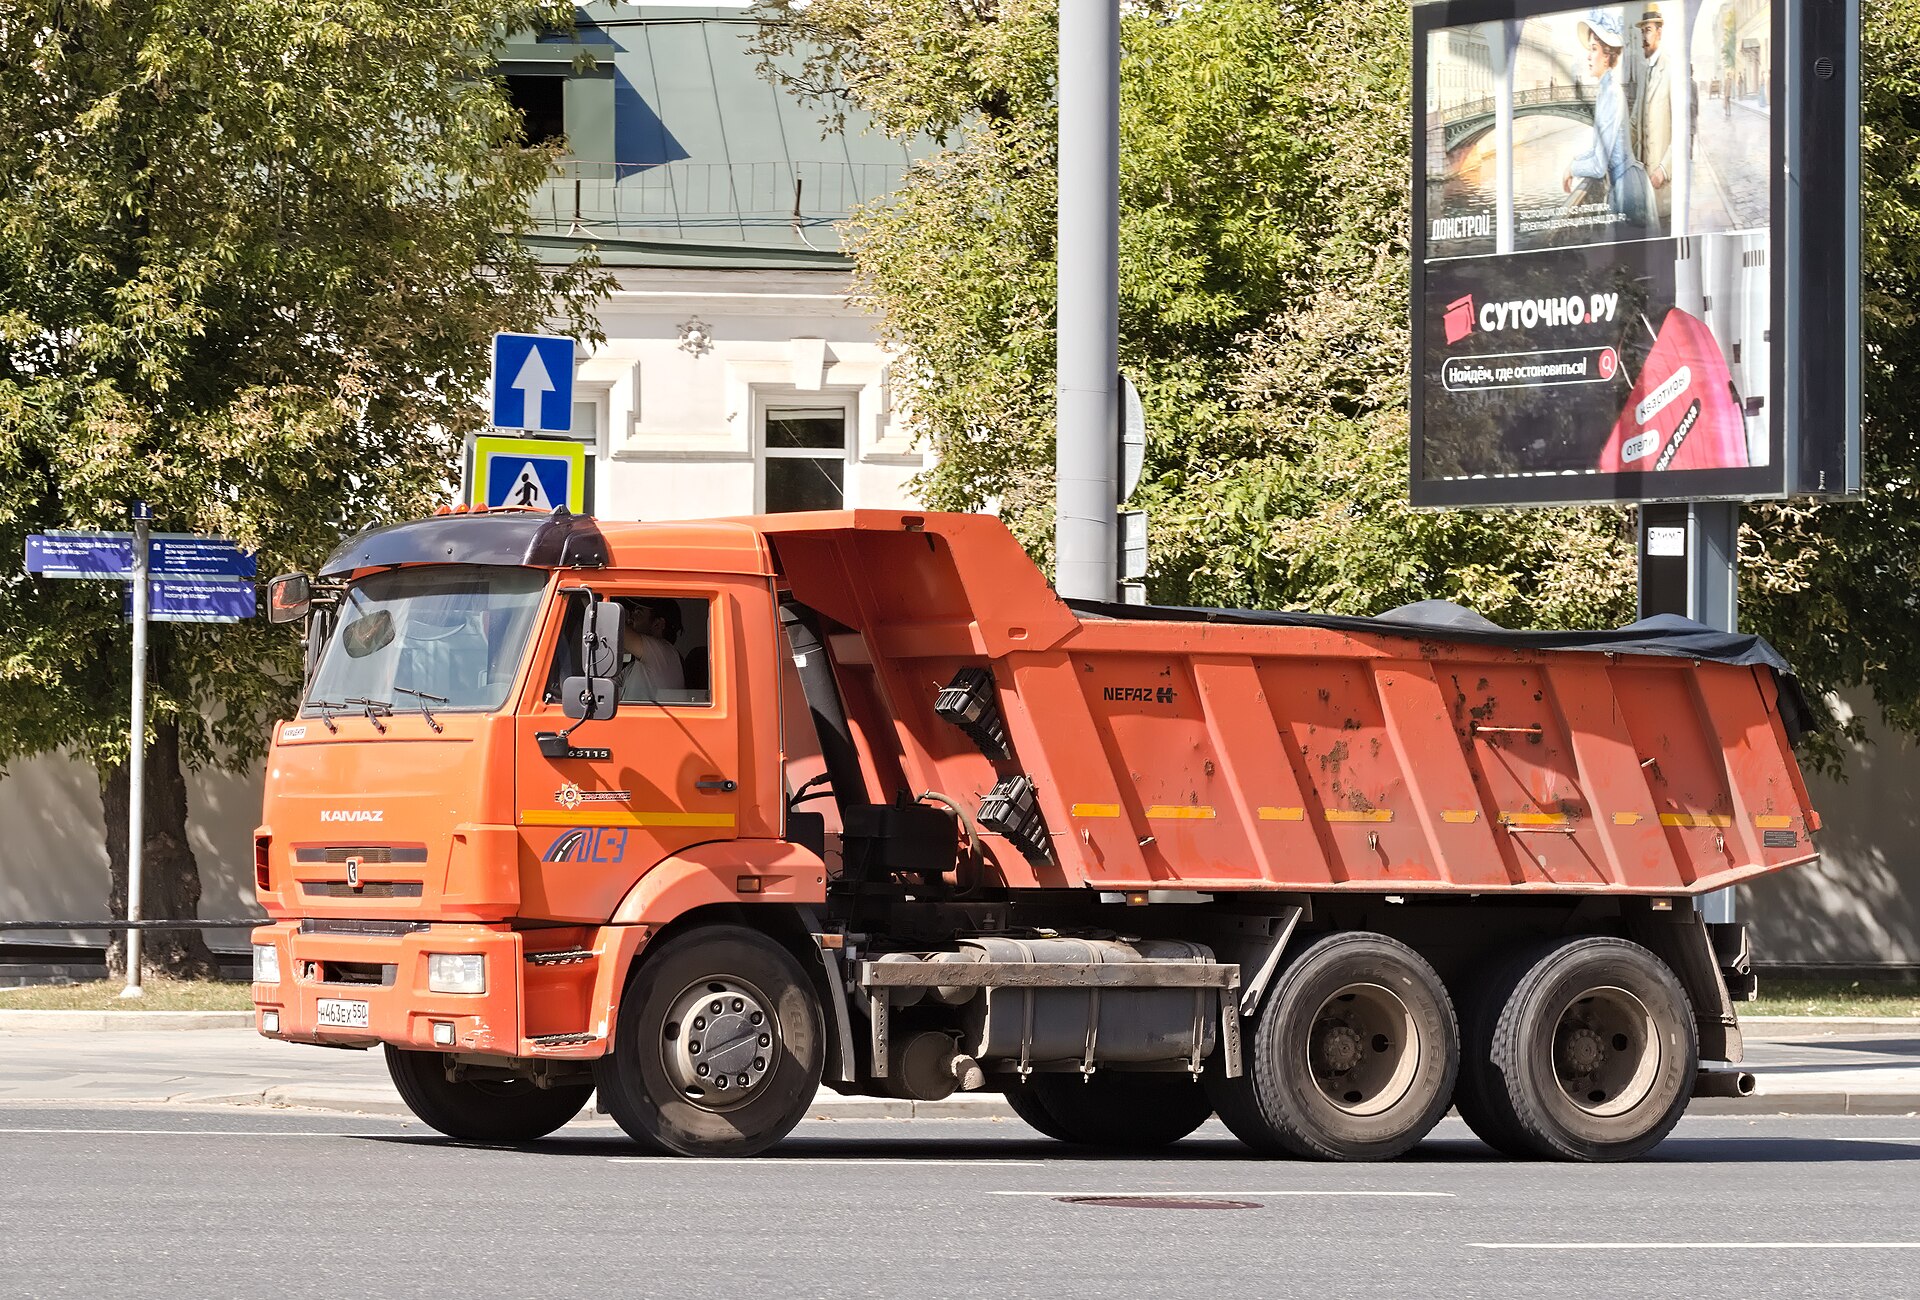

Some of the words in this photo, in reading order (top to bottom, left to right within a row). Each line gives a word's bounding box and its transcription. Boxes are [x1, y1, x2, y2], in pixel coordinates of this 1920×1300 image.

[1430, 209, 1490, 240] ДОНСТРОЙ
[1479, 292, 1619, 332] СУТОЧНО.РУ
[1449, 365, 1494, 383] Найдём,
[1495, 367, 1514, 382] где
[1103, 687, 1153, 702] NEFAZ
[568, 750, 609, 758] 65115
[320, 810, 384, 822] KAMAZ
